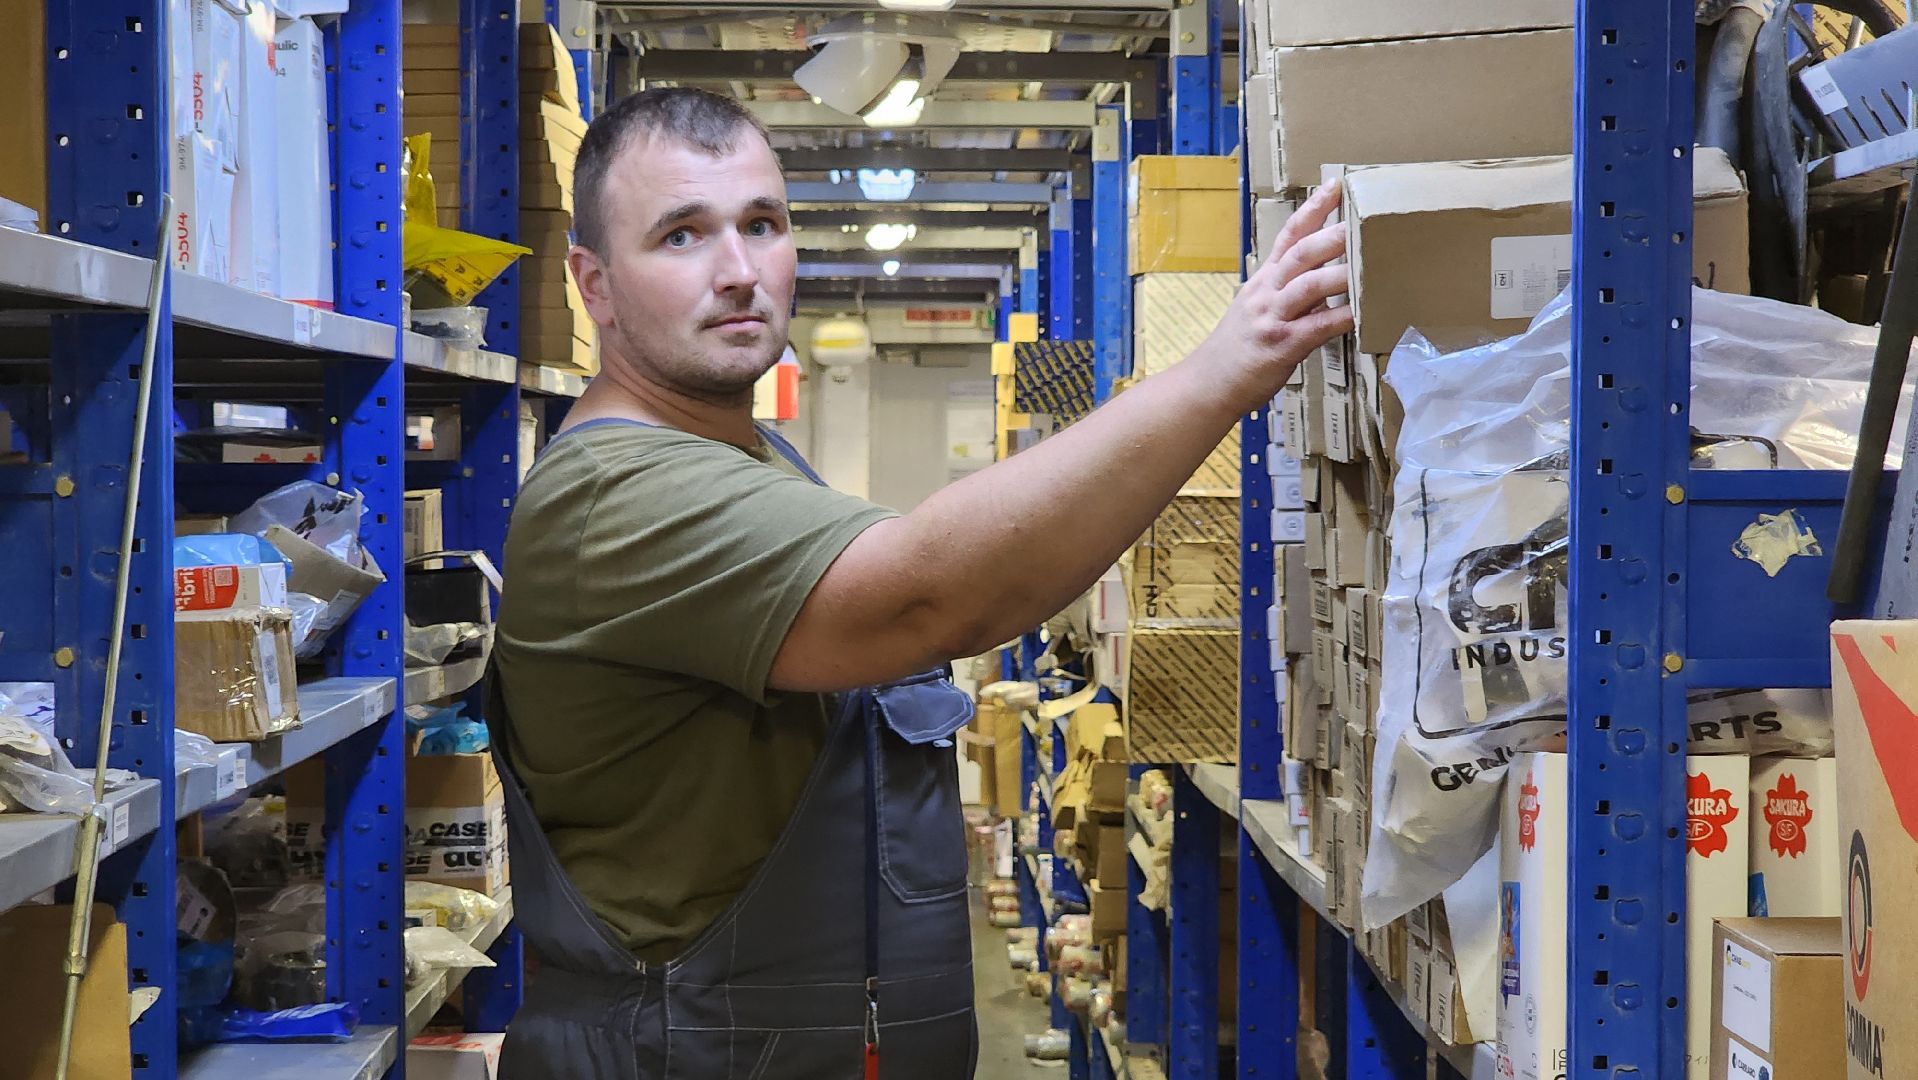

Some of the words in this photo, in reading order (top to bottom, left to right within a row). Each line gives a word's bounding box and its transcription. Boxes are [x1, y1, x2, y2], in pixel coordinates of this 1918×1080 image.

[1142, 584, 1158, 618] CNH
[1686, 711, 1783, 743] RTS
[1768, 798, 1806, 816] SAKURA
[428, 822, 488, 838] CASE
[1846, 1000, 1883, 1080] COMMA
